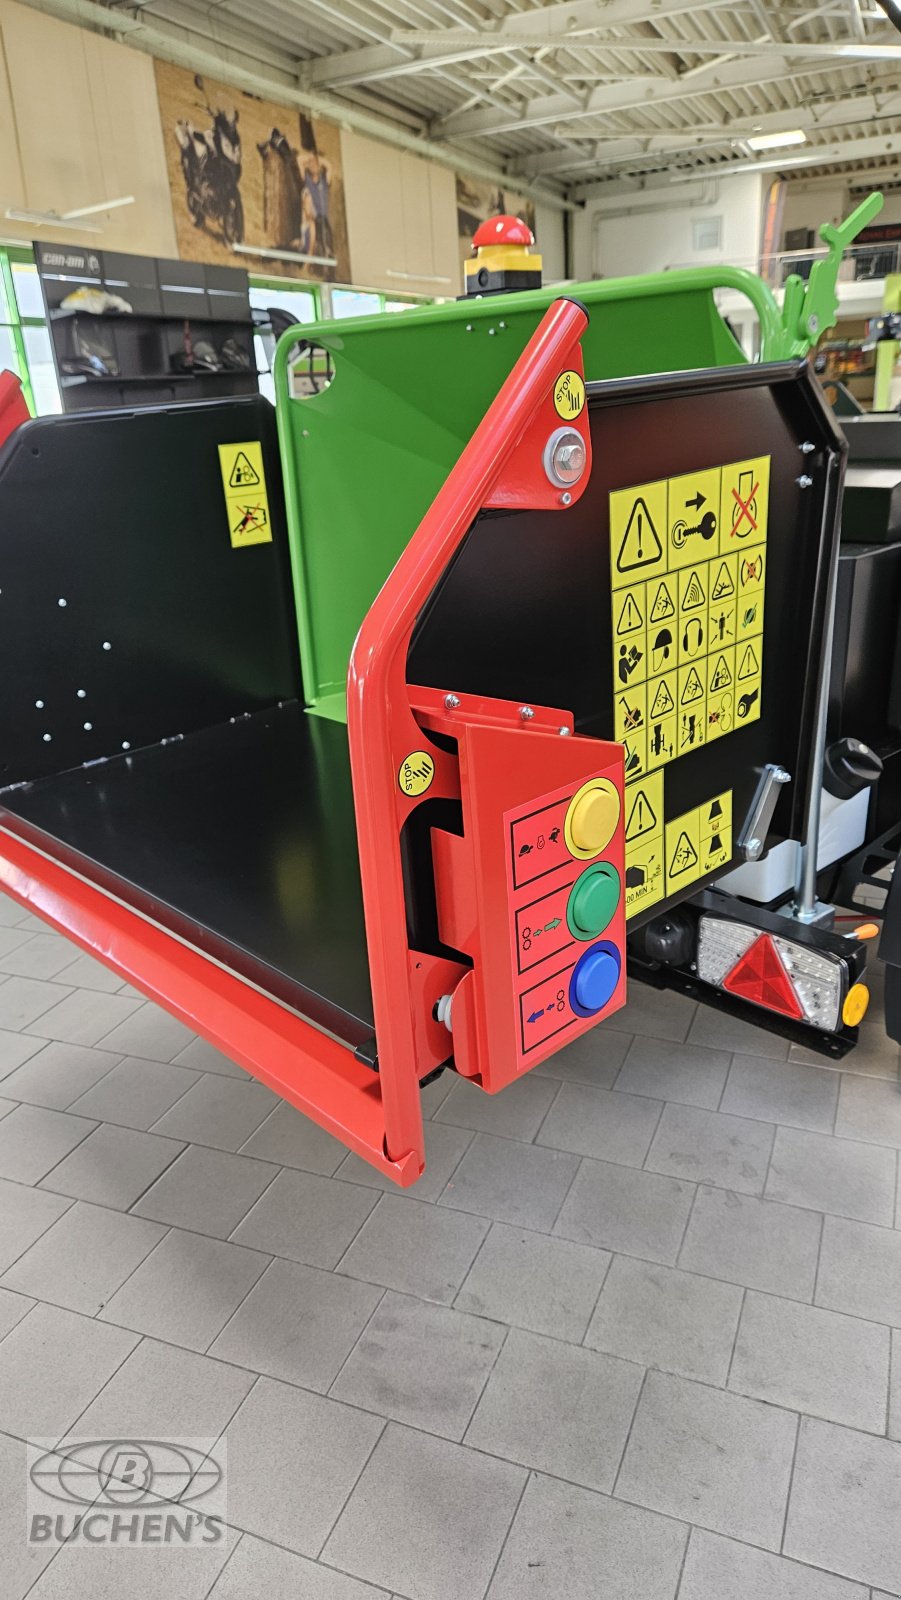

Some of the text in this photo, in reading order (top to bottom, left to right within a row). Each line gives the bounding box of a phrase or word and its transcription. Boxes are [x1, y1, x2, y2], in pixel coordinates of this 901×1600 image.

[556, 374, 571, 402] STOP
[404, 763, 412, 790] STOP
[625, 886, 648, 903] 00 MIN
